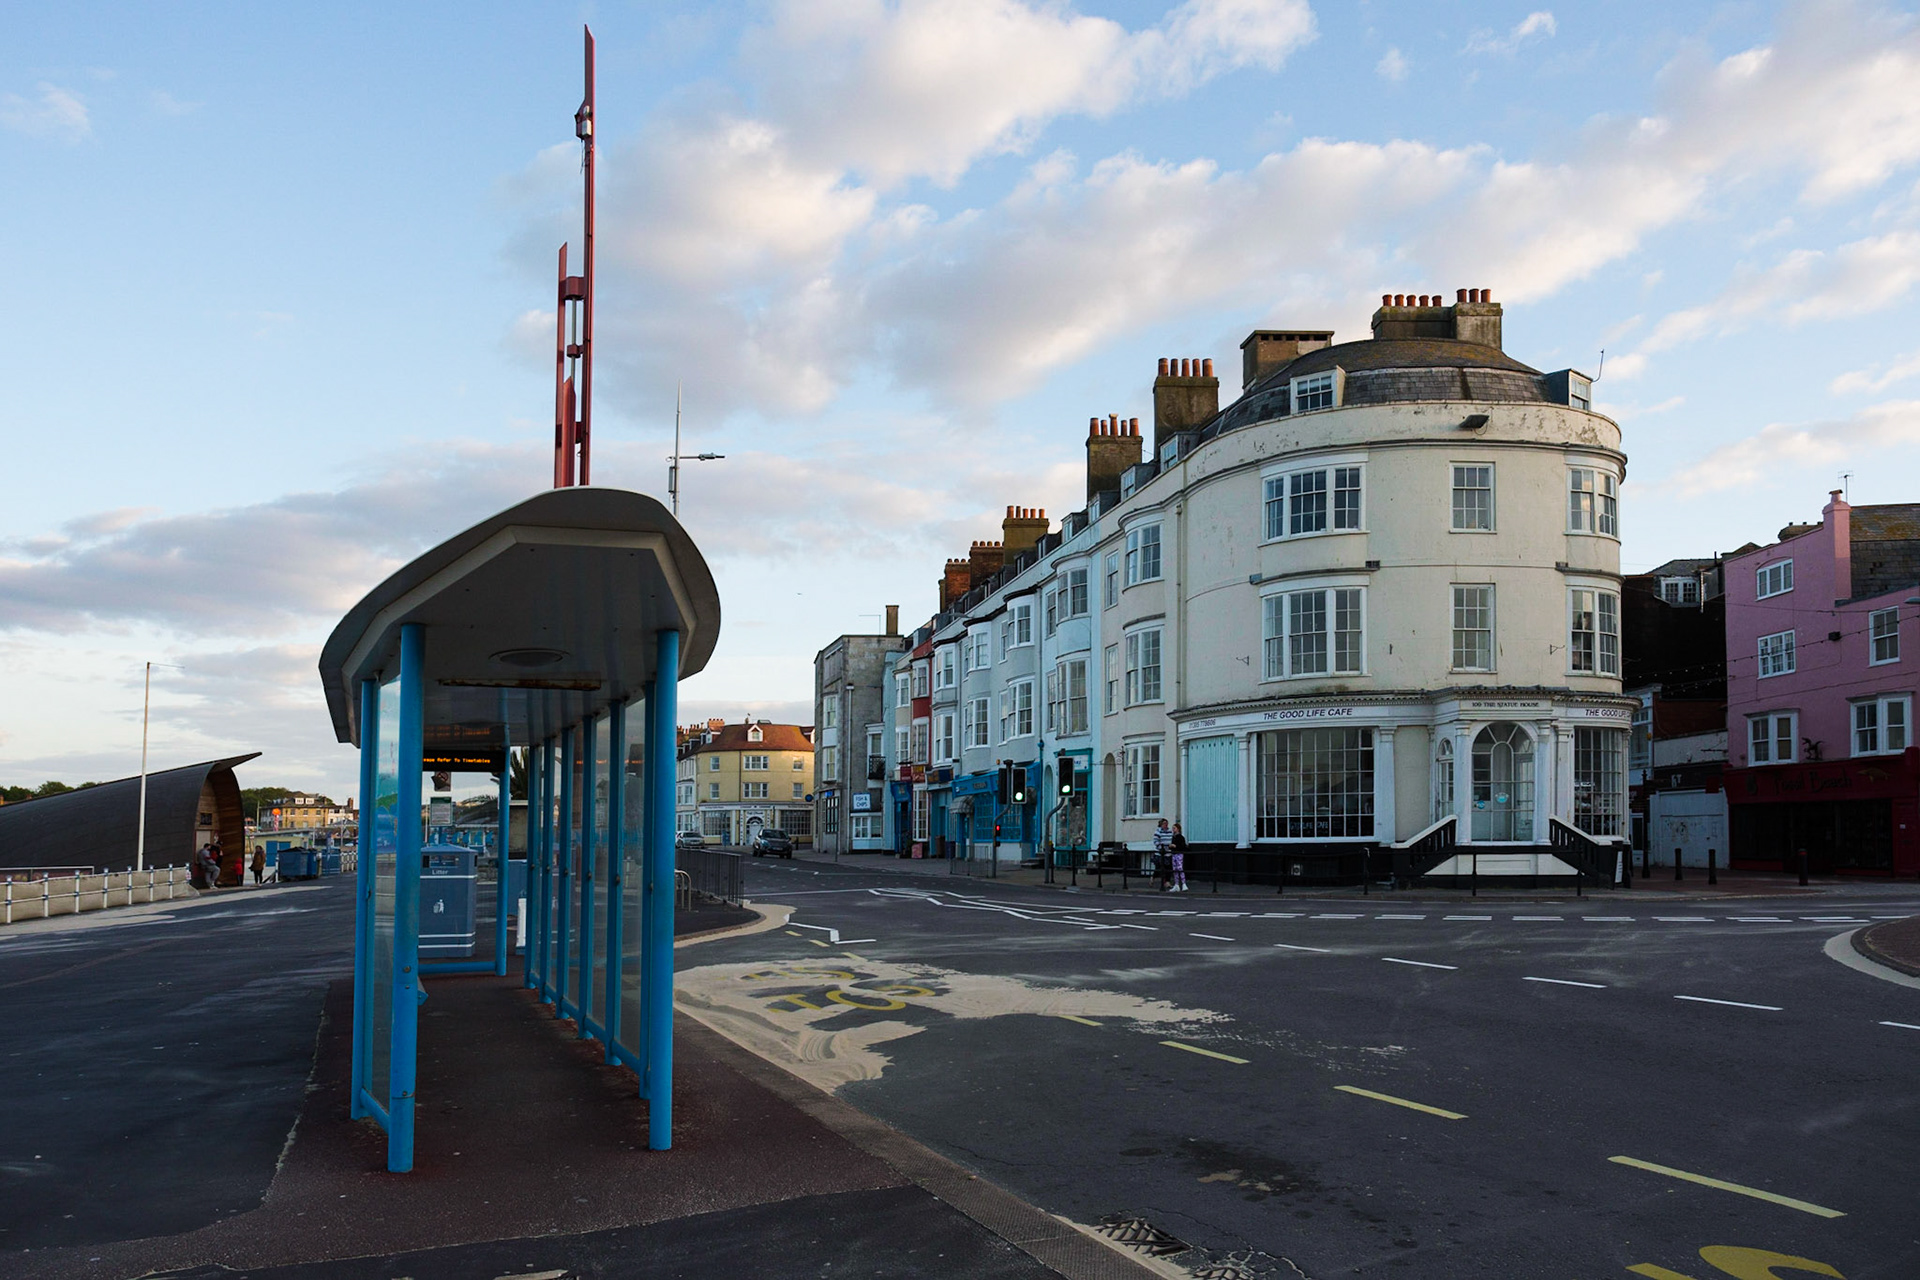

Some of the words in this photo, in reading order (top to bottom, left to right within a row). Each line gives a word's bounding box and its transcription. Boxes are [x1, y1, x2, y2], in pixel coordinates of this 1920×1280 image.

[1263, 712, 1278, 720] THE
[1279, 710, 1304, 719] GOOD
[1306, 709, 1326, 717] LIFE
[1328, 708, 1353, 716] CAFE
[1601, 709, 1618, 717] GOOD
